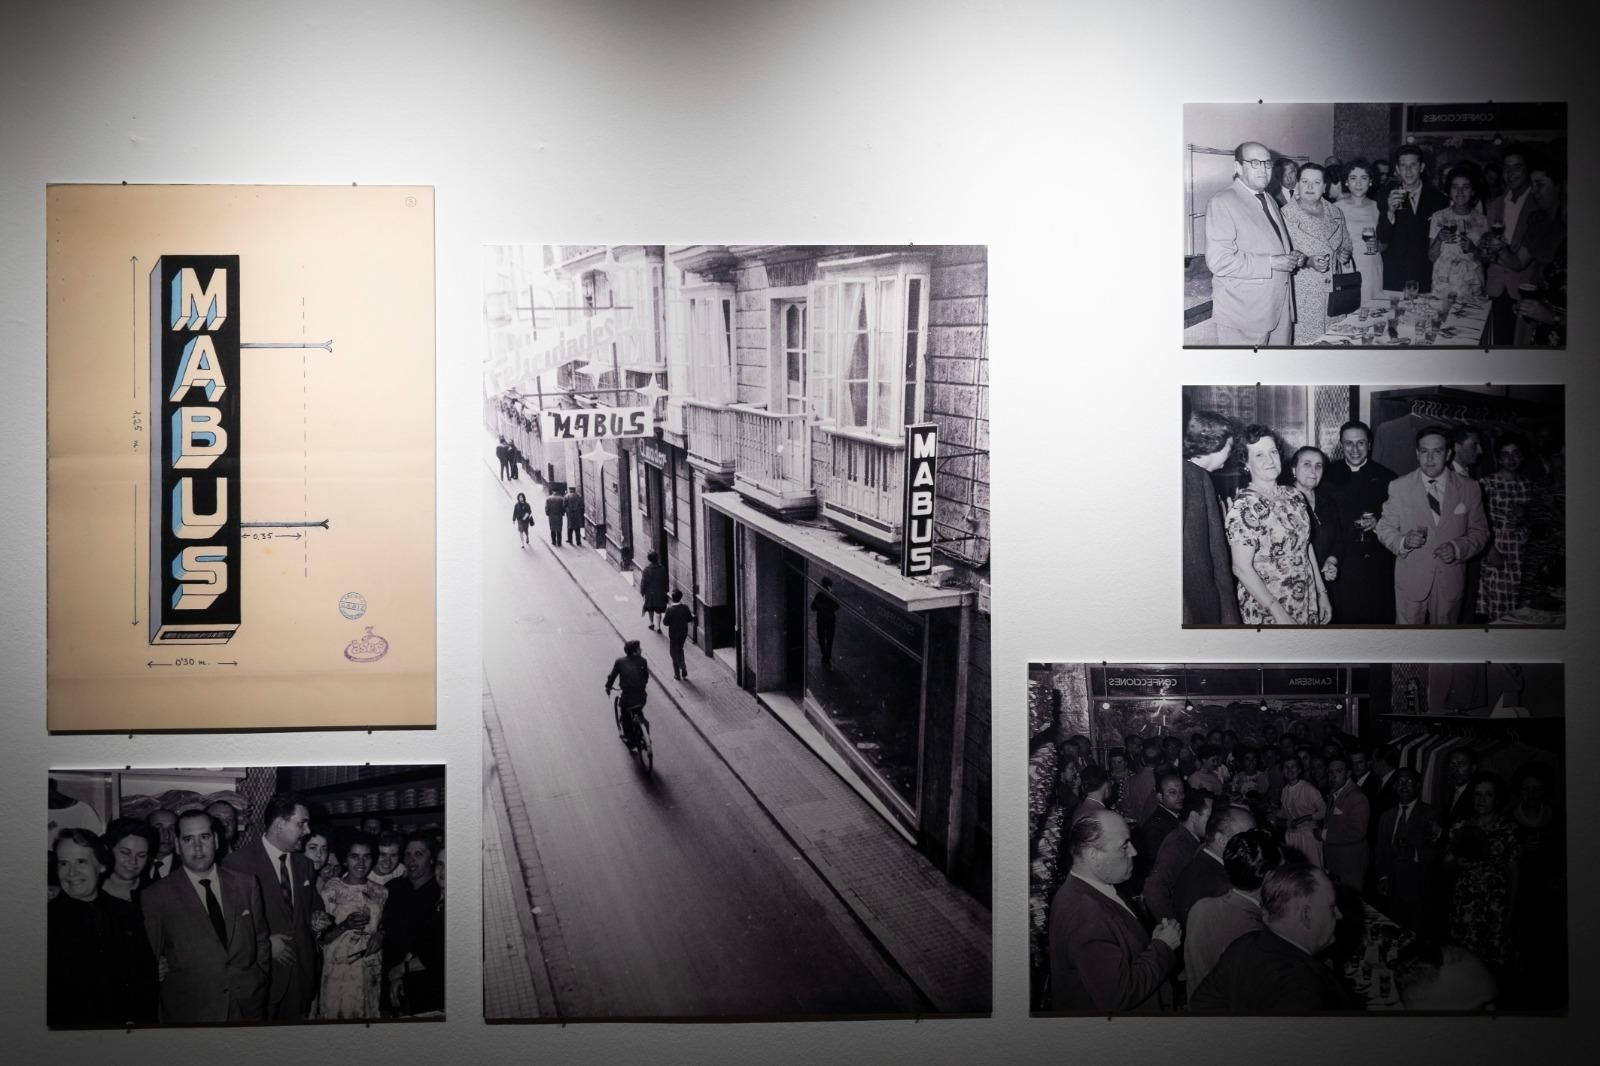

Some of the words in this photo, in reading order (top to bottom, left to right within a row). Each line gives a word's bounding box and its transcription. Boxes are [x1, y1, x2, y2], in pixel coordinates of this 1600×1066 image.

[169, 267, 228, 610] MABUS
[547, 411, 646, 438] MABUS
[910, 432, 936, 572] MABUS
